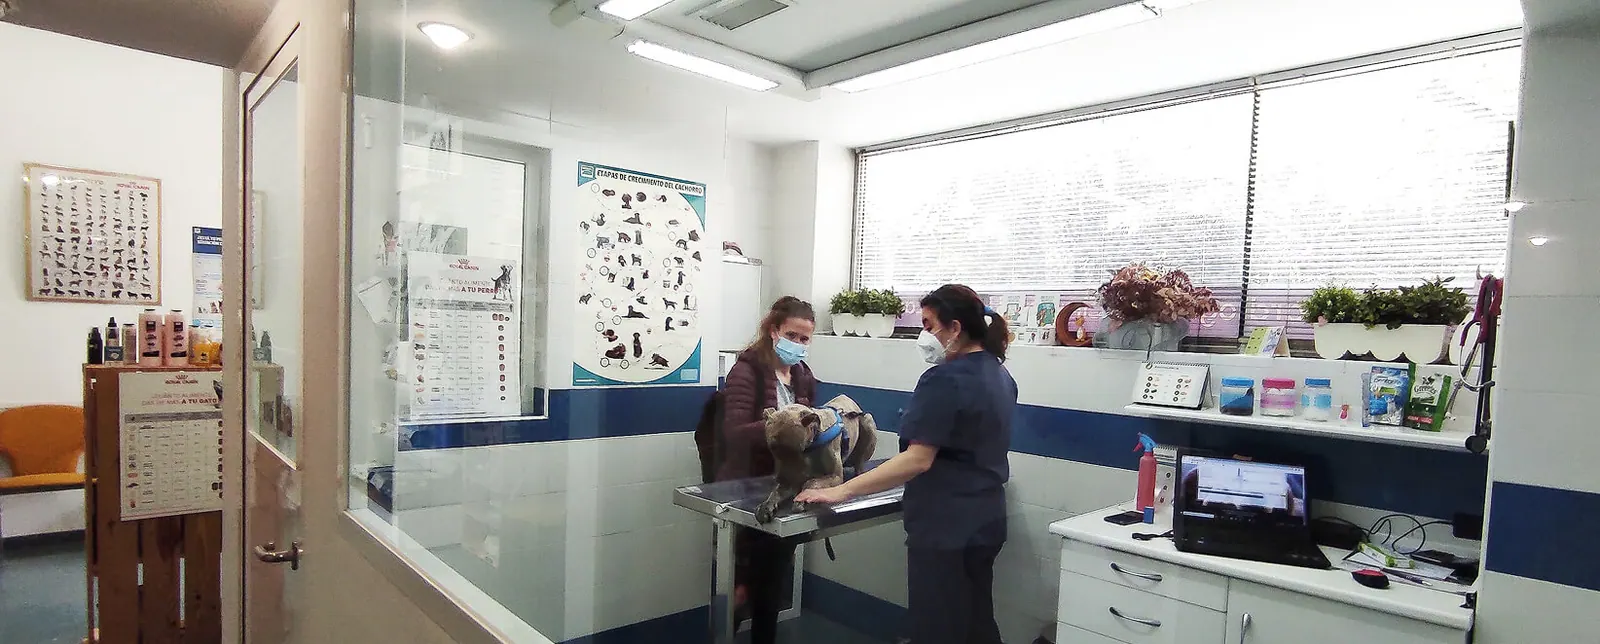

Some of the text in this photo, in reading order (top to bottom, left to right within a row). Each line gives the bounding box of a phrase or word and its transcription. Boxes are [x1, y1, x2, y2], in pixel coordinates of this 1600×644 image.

[597, 169, 618, 180] ETAPAS
[619, 173, 627, 181] DE
[628, 175, 664, 187] CRECIMIENTO
[674, 184, 702, 194] CACHORRO
